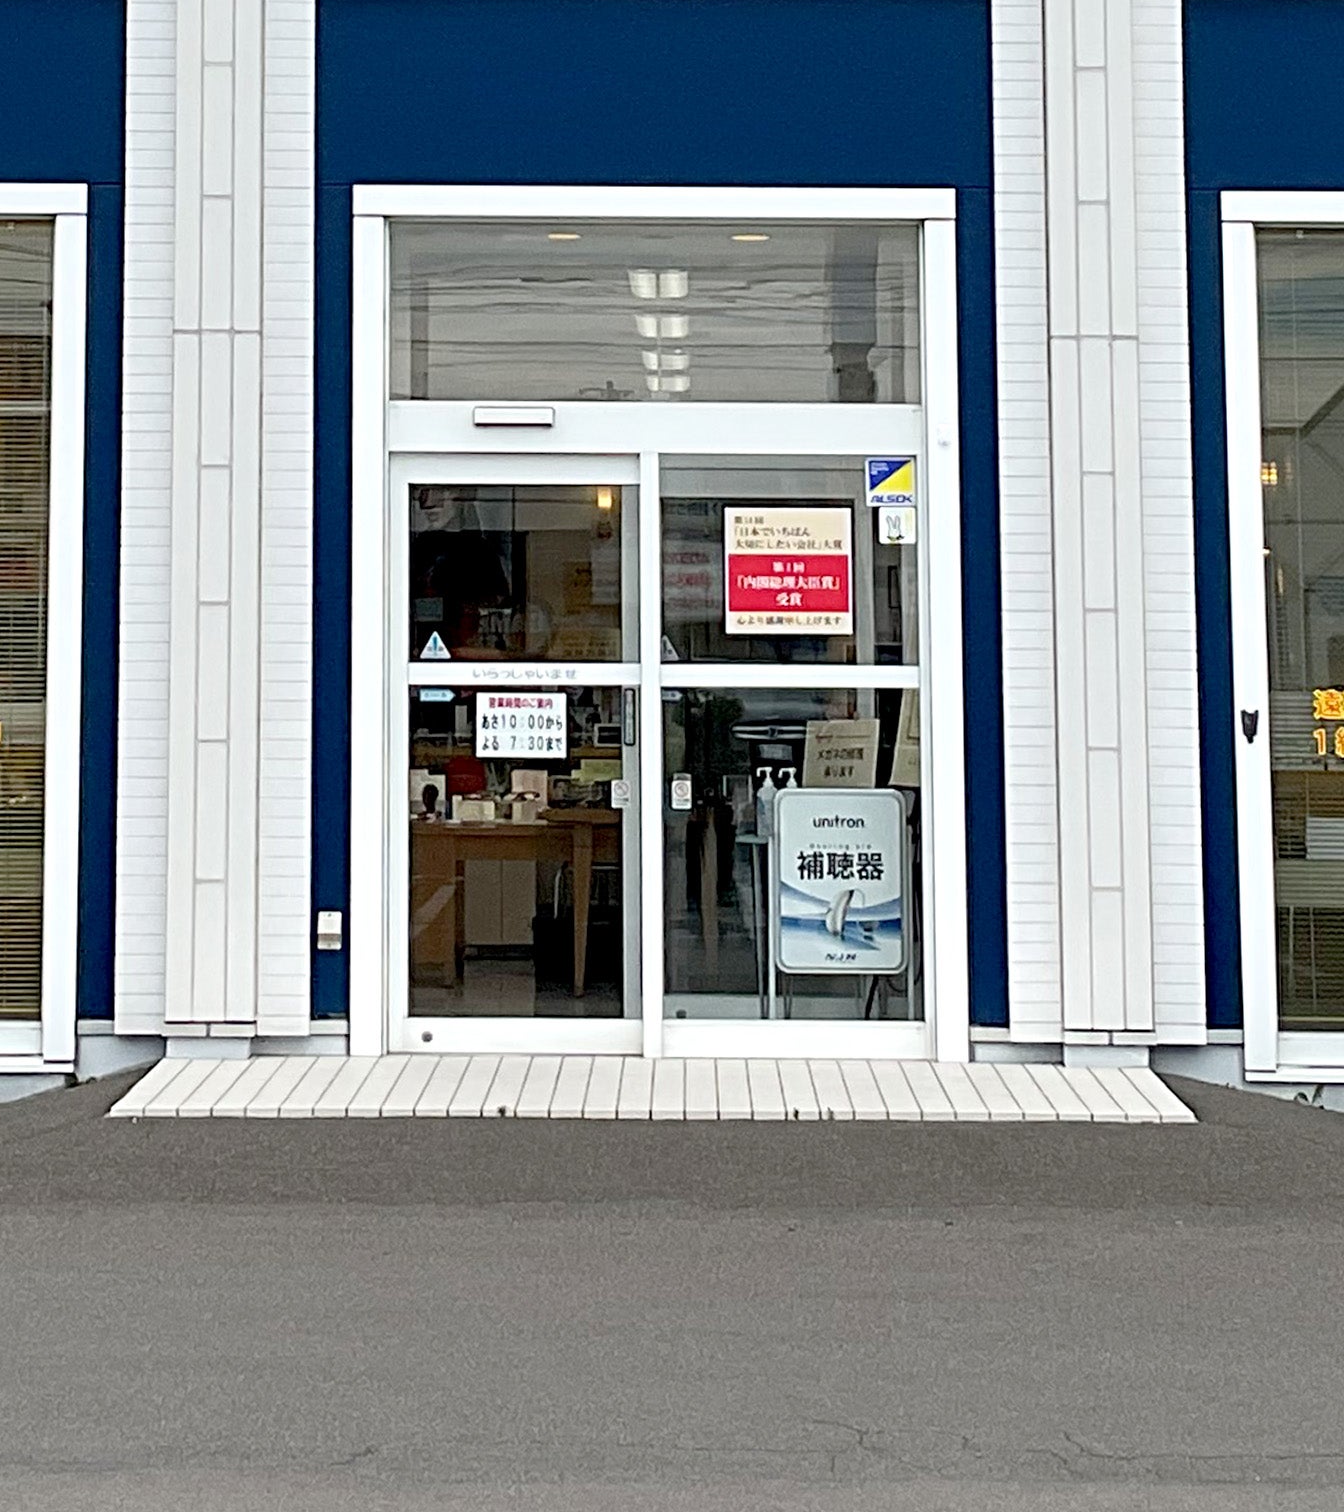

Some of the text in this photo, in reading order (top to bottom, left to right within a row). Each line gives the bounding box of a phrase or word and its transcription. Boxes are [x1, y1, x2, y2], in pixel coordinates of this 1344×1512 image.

[870, 493, 913, 504] ALSOK
[472, 669, 578, 680] いらっしゃいませ
[488, 697, 554, 710] 営業時間のご案内
[812, 814, 866, 829] unitron
[796, 851, 885, 881] 補聴器
